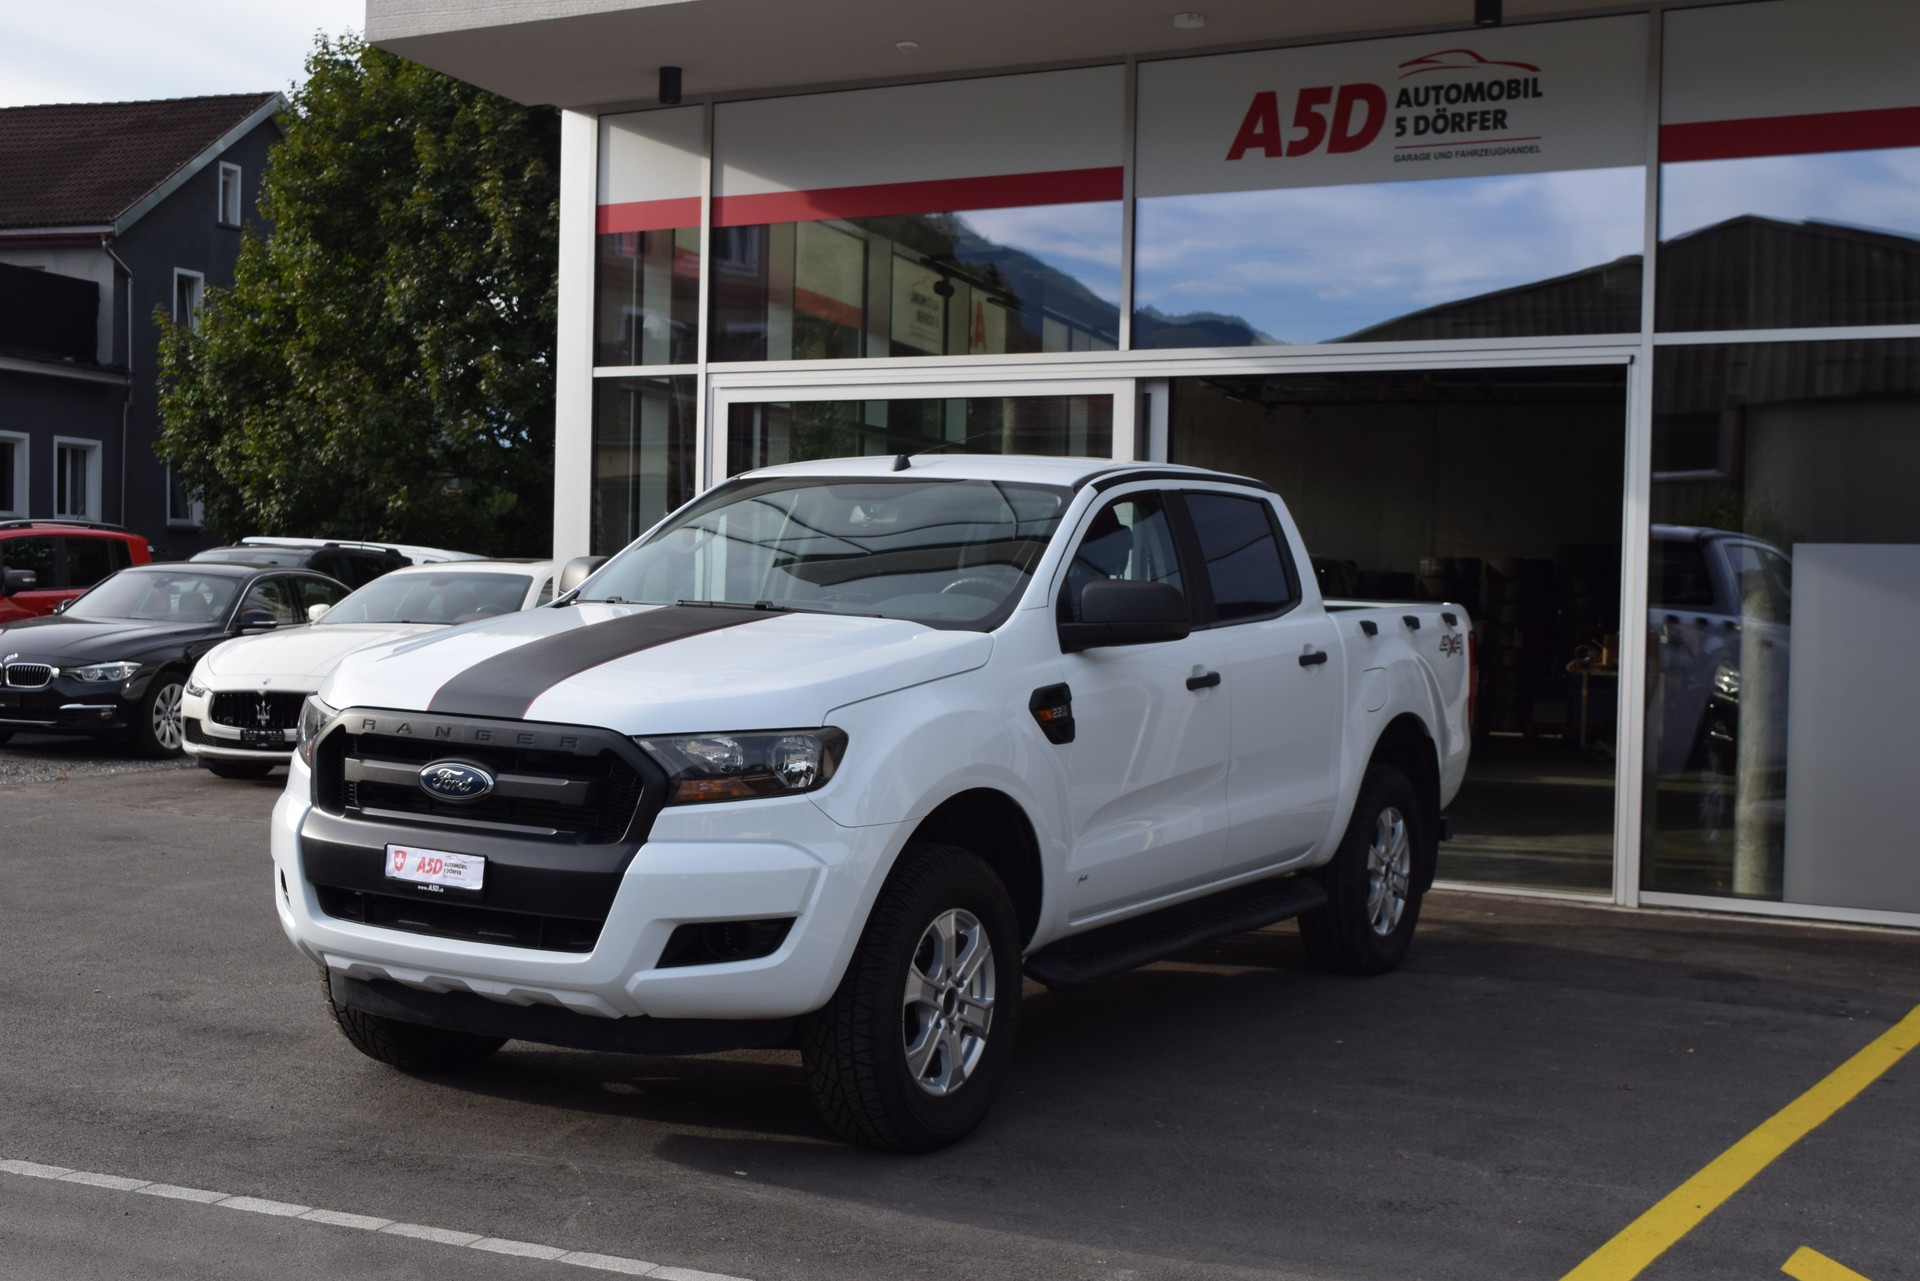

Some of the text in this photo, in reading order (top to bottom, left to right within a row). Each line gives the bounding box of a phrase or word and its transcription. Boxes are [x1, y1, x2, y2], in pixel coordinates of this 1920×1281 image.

[1395, 77, 1543, 109] AUTOMOBIL
[1225, 83, 1388, 161] A5D
[1395, 108, 1508, 138] 5 DÖRFER
[1393, 145, 1541, 163] GARAGE UND FAHRZEUGHANDEL
[361, 718, 581, 748] RANGER
[432, 767, 473, 792] Ford
[416, 857, 443, 875] A5D
